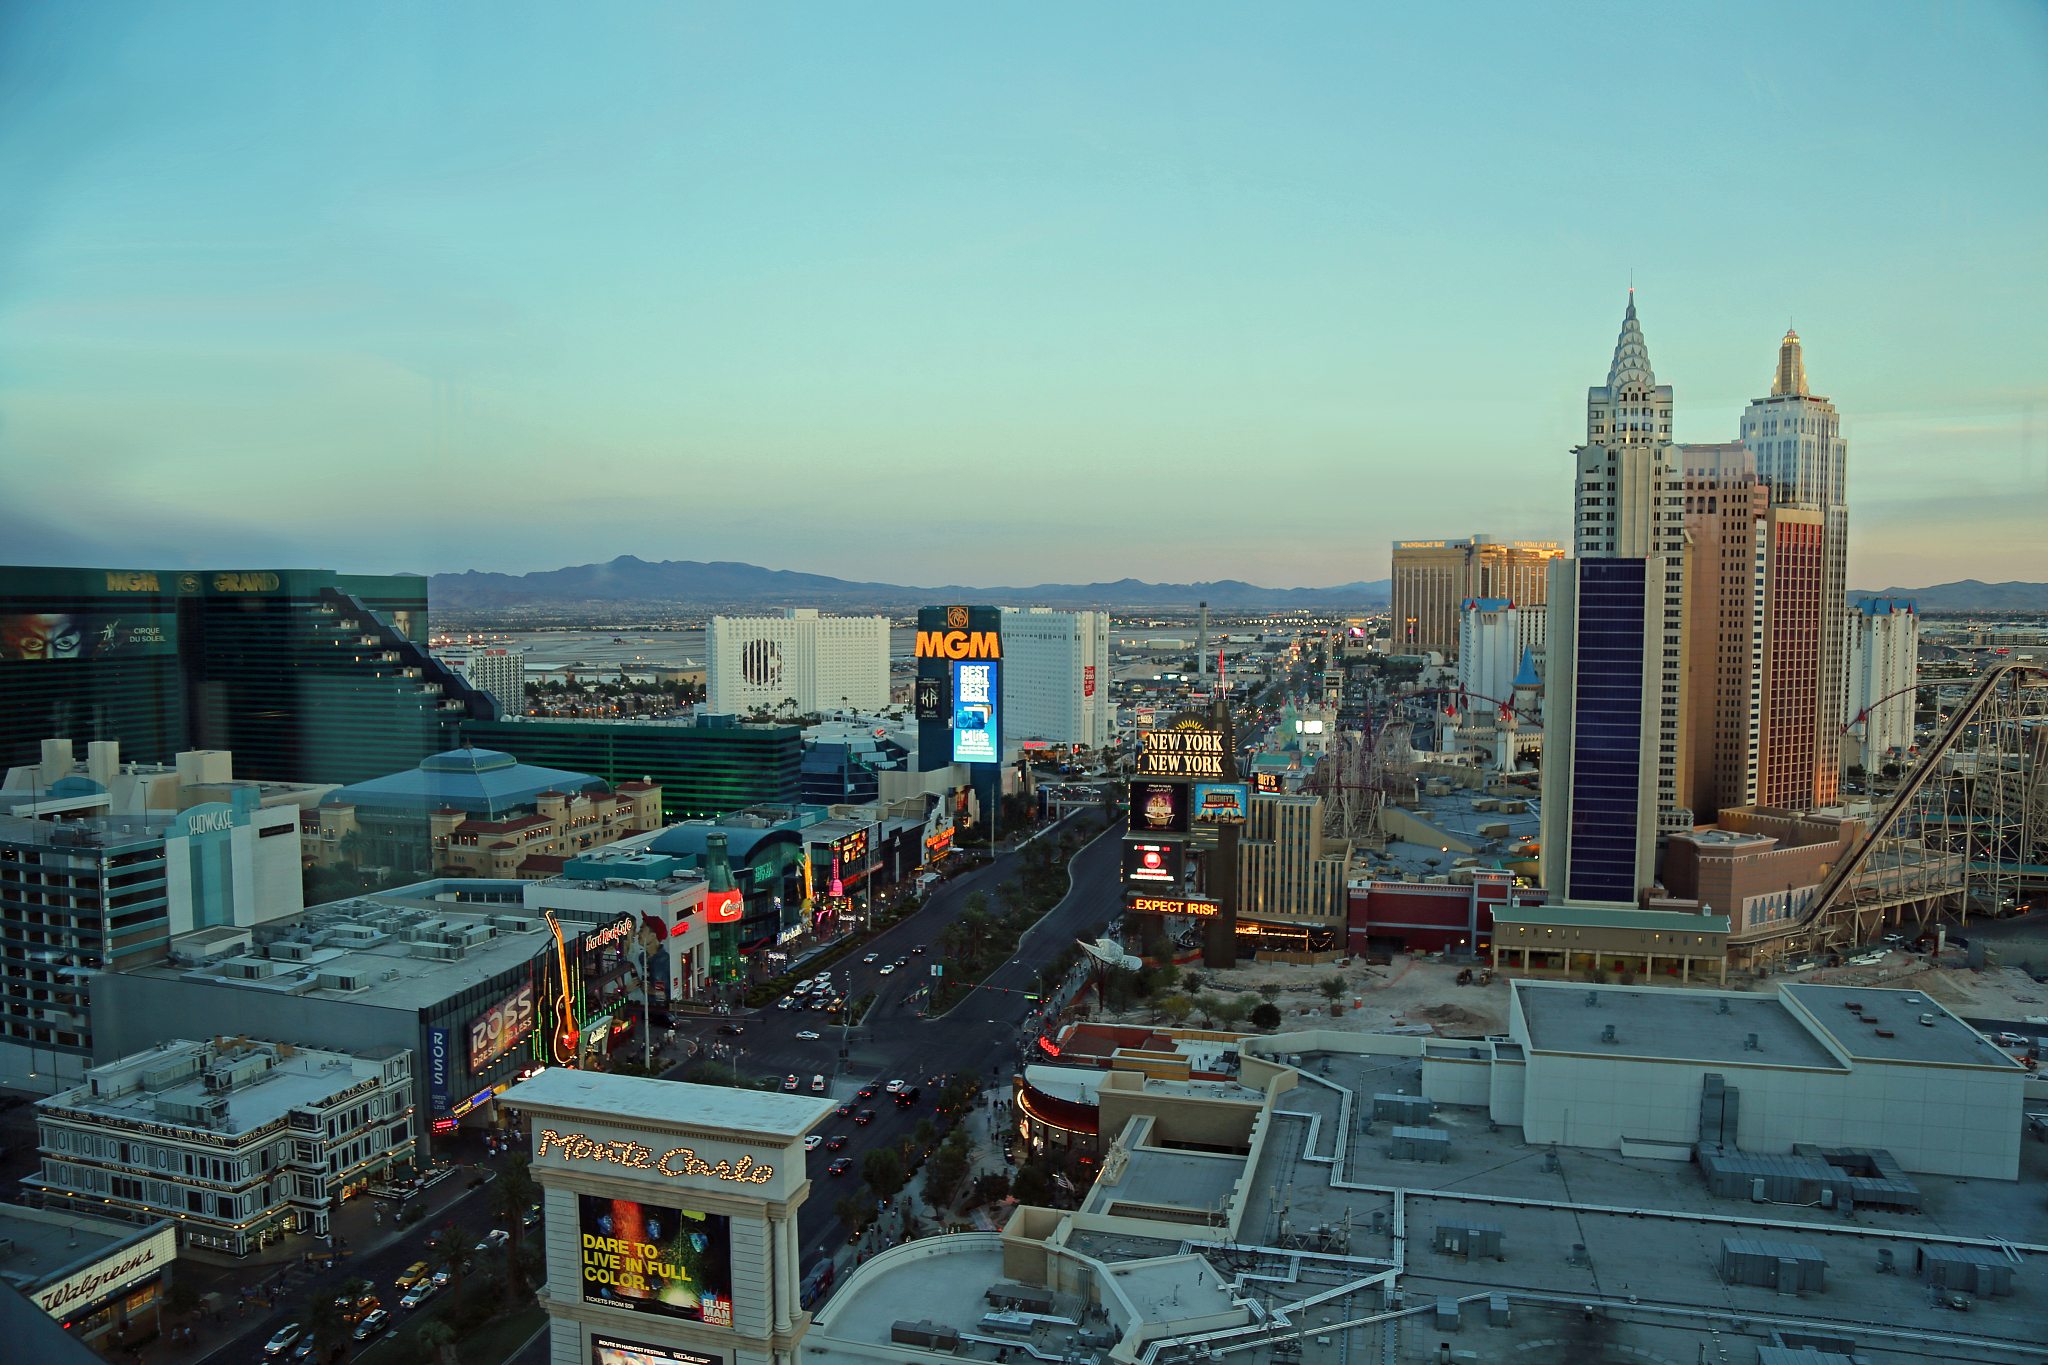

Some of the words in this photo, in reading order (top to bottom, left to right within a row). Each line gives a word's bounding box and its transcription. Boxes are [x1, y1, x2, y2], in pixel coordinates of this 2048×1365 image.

[106, 572, 160, 592] MGM
[213, 573, 280, 592] GRAND
[134, 628, 160, 636] CIRQUE
[914, 630, 1000, 660] MGM
[960, 666, 990, 678] BEST
[960, 684, 990, 697] BEST
[1148, 734, 1181, 750] NEW
[1184, 734, 1222, 751] YORK
[1148, 754, 1181, 771] NEW
[1184, 756, 1222, 772] YORK
[188, 810, 234, 836] SHOWCASE
[1187, 903, 1218, 916] IRISH
[473, 988, 531, 1053] ROSS
[474, 1043, 497, 1067] DRESS
[500, 1032, 513, 1047] FOR
[515, 1017, 532, 1036] LESS
[434, 1032, 444, 1085] ROSS
[138, 1124, 163, 1135] SMITH
[167, 1128, 173, 1137] &
[176, 1130, 226, 1146] WOLLENSKY
[238, 1131, 261, 1145] STEAKS
[538, 1129, 656, 1169] Monte
[657, 1148, 774, 1184] Carlo
[173, 1176, 190, 1184] SMITH
[583, 1234, 629, 1254] DARE
[634, 1243, 658, 1259] TO
[584, 1250, 620, 1269] LIVE
[626, 1258, 642, 1273] IN
[648, 1262, 692, 1281] FULL
[42, 1249, 155, 1312] Walgreens
[584, 1267, 650, 1291] COLOR.
[586, 1296, 607, 1304] TICKETS
[703, 1298, 730, 1310] BLUE
[703, 1307, 730, 1319] MAN
[704, 1316, 730, 1326] GROUP
[644, 1348, 667, 1357] FESTIVAL
